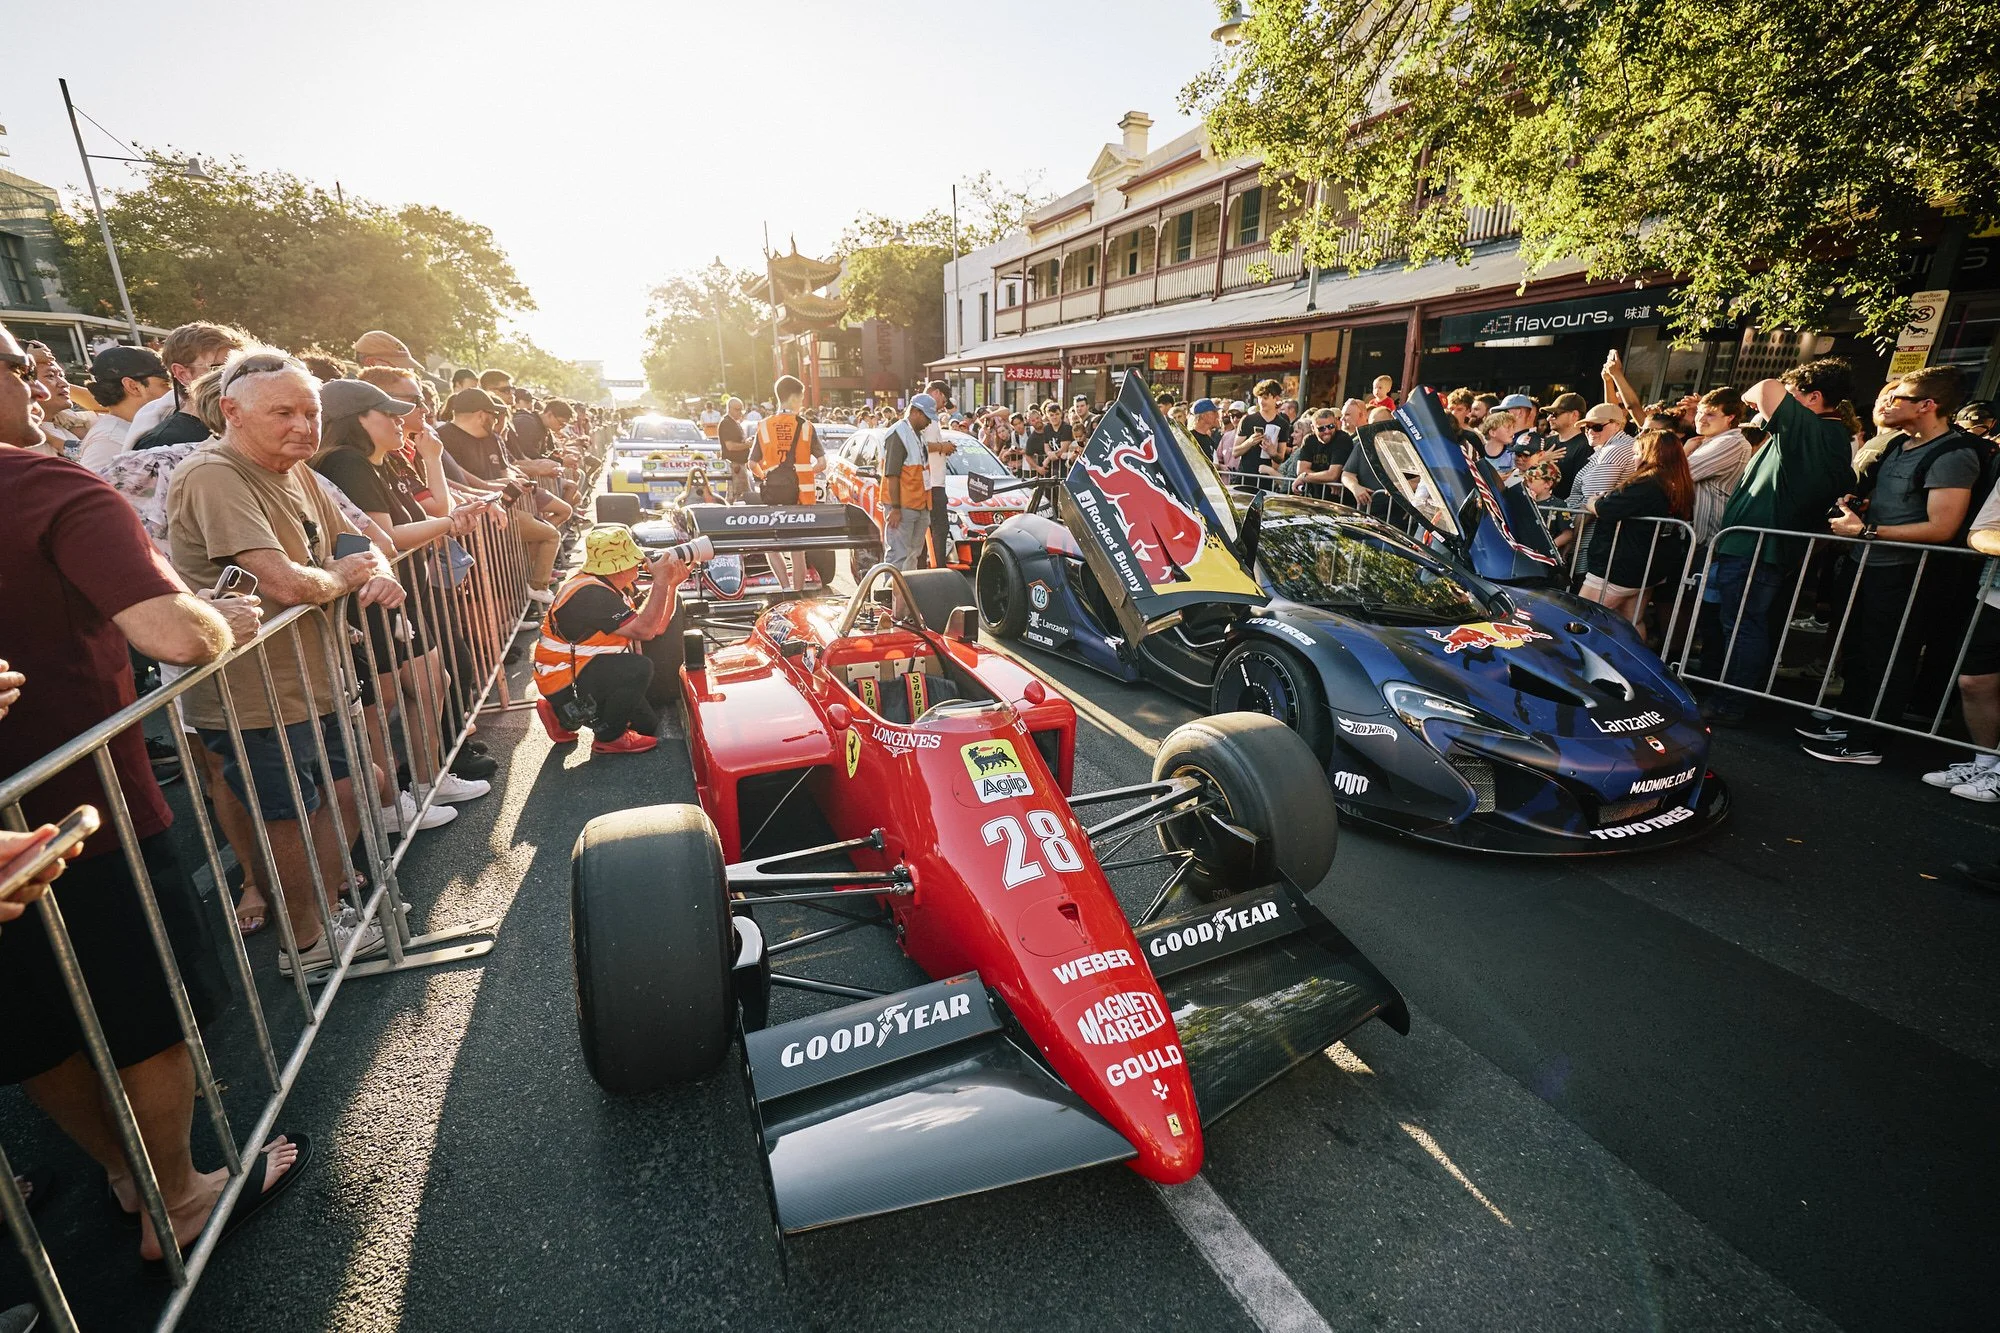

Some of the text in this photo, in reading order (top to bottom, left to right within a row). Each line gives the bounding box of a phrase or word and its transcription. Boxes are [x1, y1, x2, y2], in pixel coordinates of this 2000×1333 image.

[1624, 305, 1651, 320] 味道
[1086, 505, 1143, 592] Rocket Bunny
[1034, 588, 1046, 605] 123
[1042, 619, 1069, 636] Lanzante
[1276, 622, 1317, 646] TIRES
[1590, 710, 1665, 733] Lanzante
[872, 723, 942, 749] LONGINES
[983, 773, 1028, 797] Agip
[1629, 766, 1697, 795] MADMIKE.CO.NZ
[1589, 805, 1695, 840] TOYO TIRES
[980, 809, 1085, 890] 28
[1052, 949, 1136, 985] WEBER
[1106, 1045, 1183, 1087] GOULD
